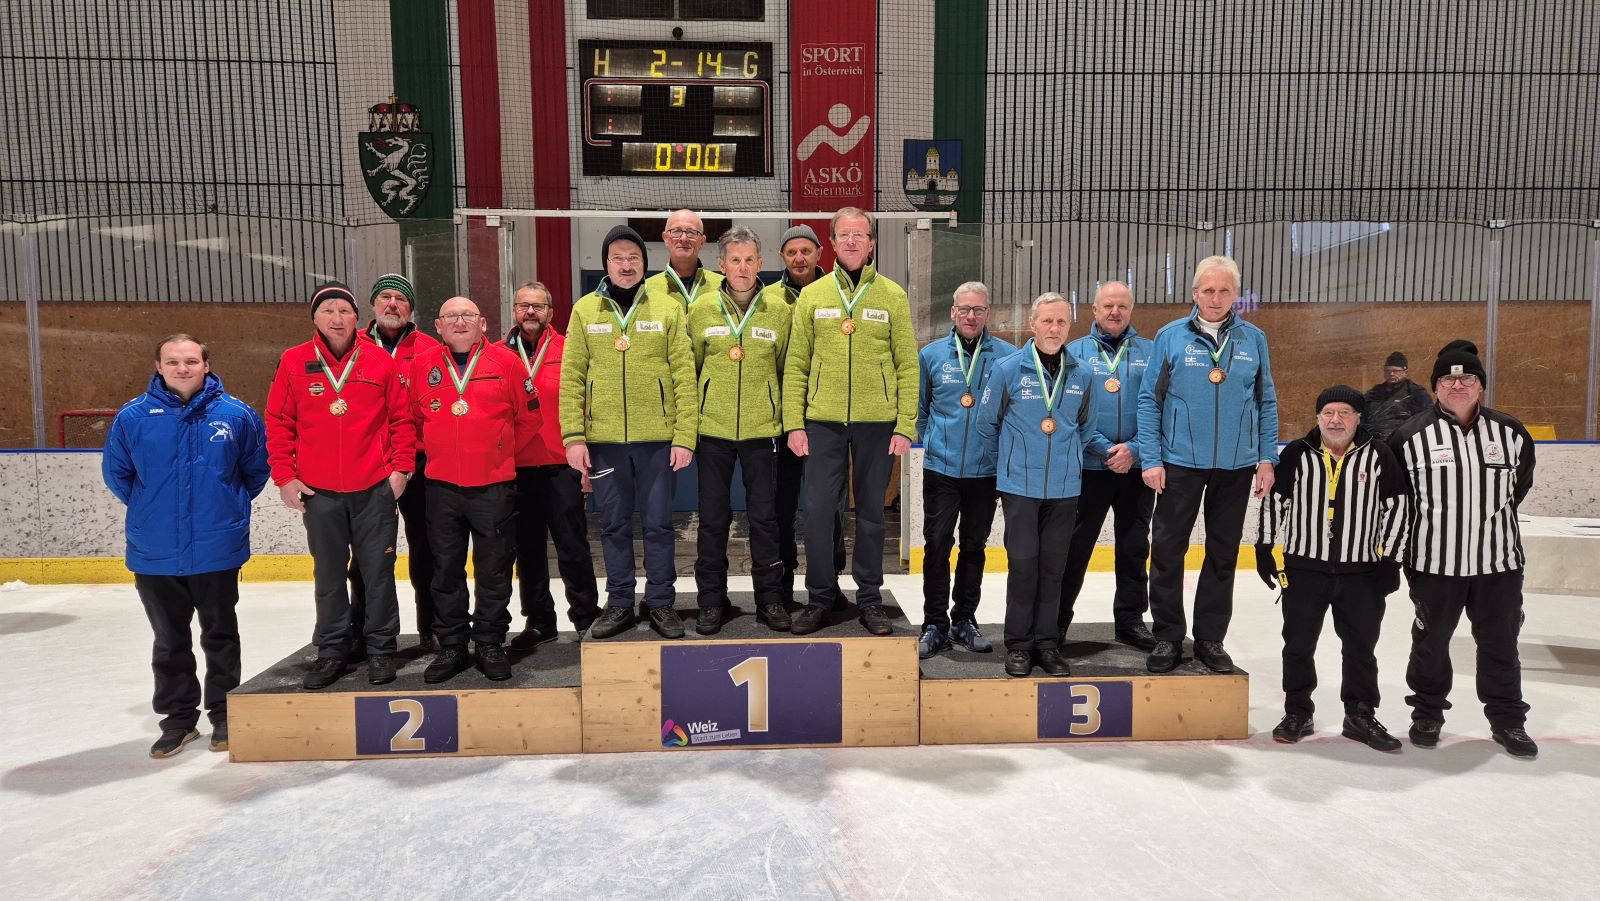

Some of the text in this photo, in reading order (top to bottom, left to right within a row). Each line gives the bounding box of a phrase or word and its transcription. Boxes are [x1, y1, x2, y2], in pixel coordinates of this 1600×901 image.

[593, 48, 610, 77] H
[742, 51, 759, 79] G
[802, 46, 863, 63] SPORT
[802, 64, 863, 77] in Österreich
[672, 87, 684, 107] 3
[804, 162, 863, 184] ASKÖ
[803, 184, 862, 196] Steiermark
[727, 656, 769, 733] 1
[1069, 684, 1102, 736] 3
[388, 698, 426, 752] 2
[687, 720, 719, 734] Weiz
[693, 731, 738, 742] Stadt zum Leben
